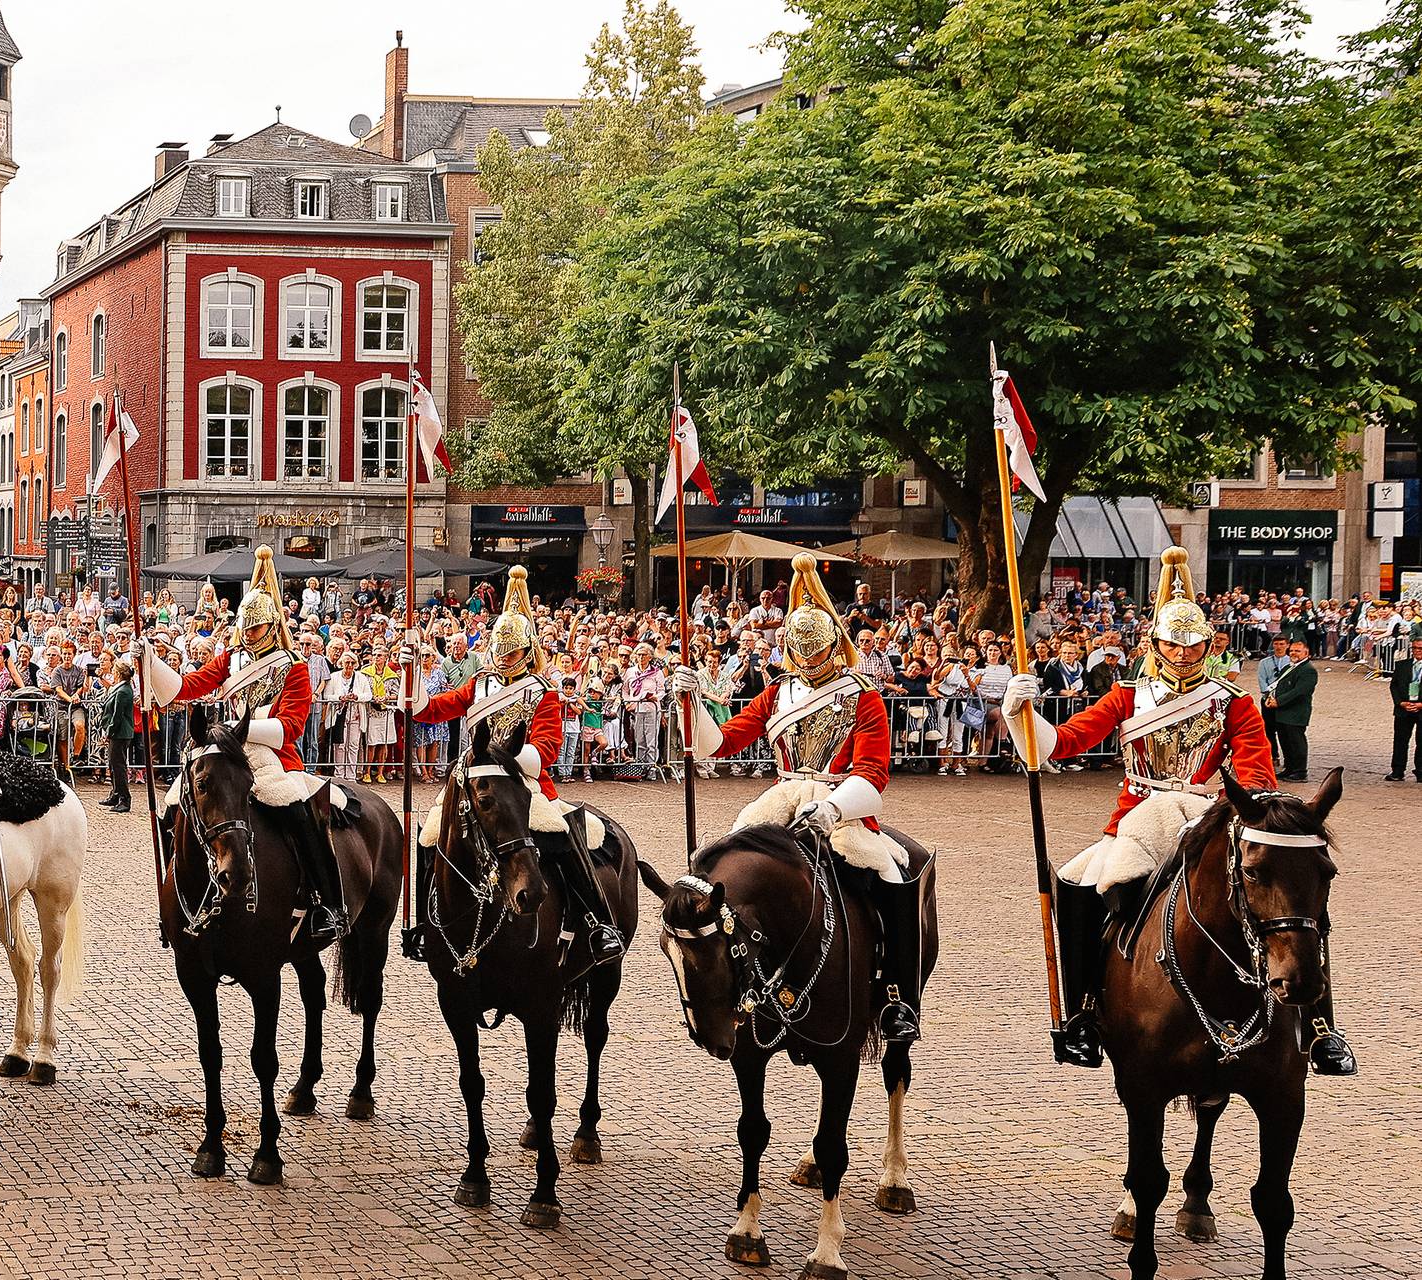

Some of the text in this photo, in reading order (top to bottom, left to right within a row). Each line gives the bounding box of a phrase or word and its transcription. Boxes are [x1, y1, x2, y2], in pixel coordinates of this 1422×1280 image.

[1218, 526, 1333, 539] THE BODY SHOP
